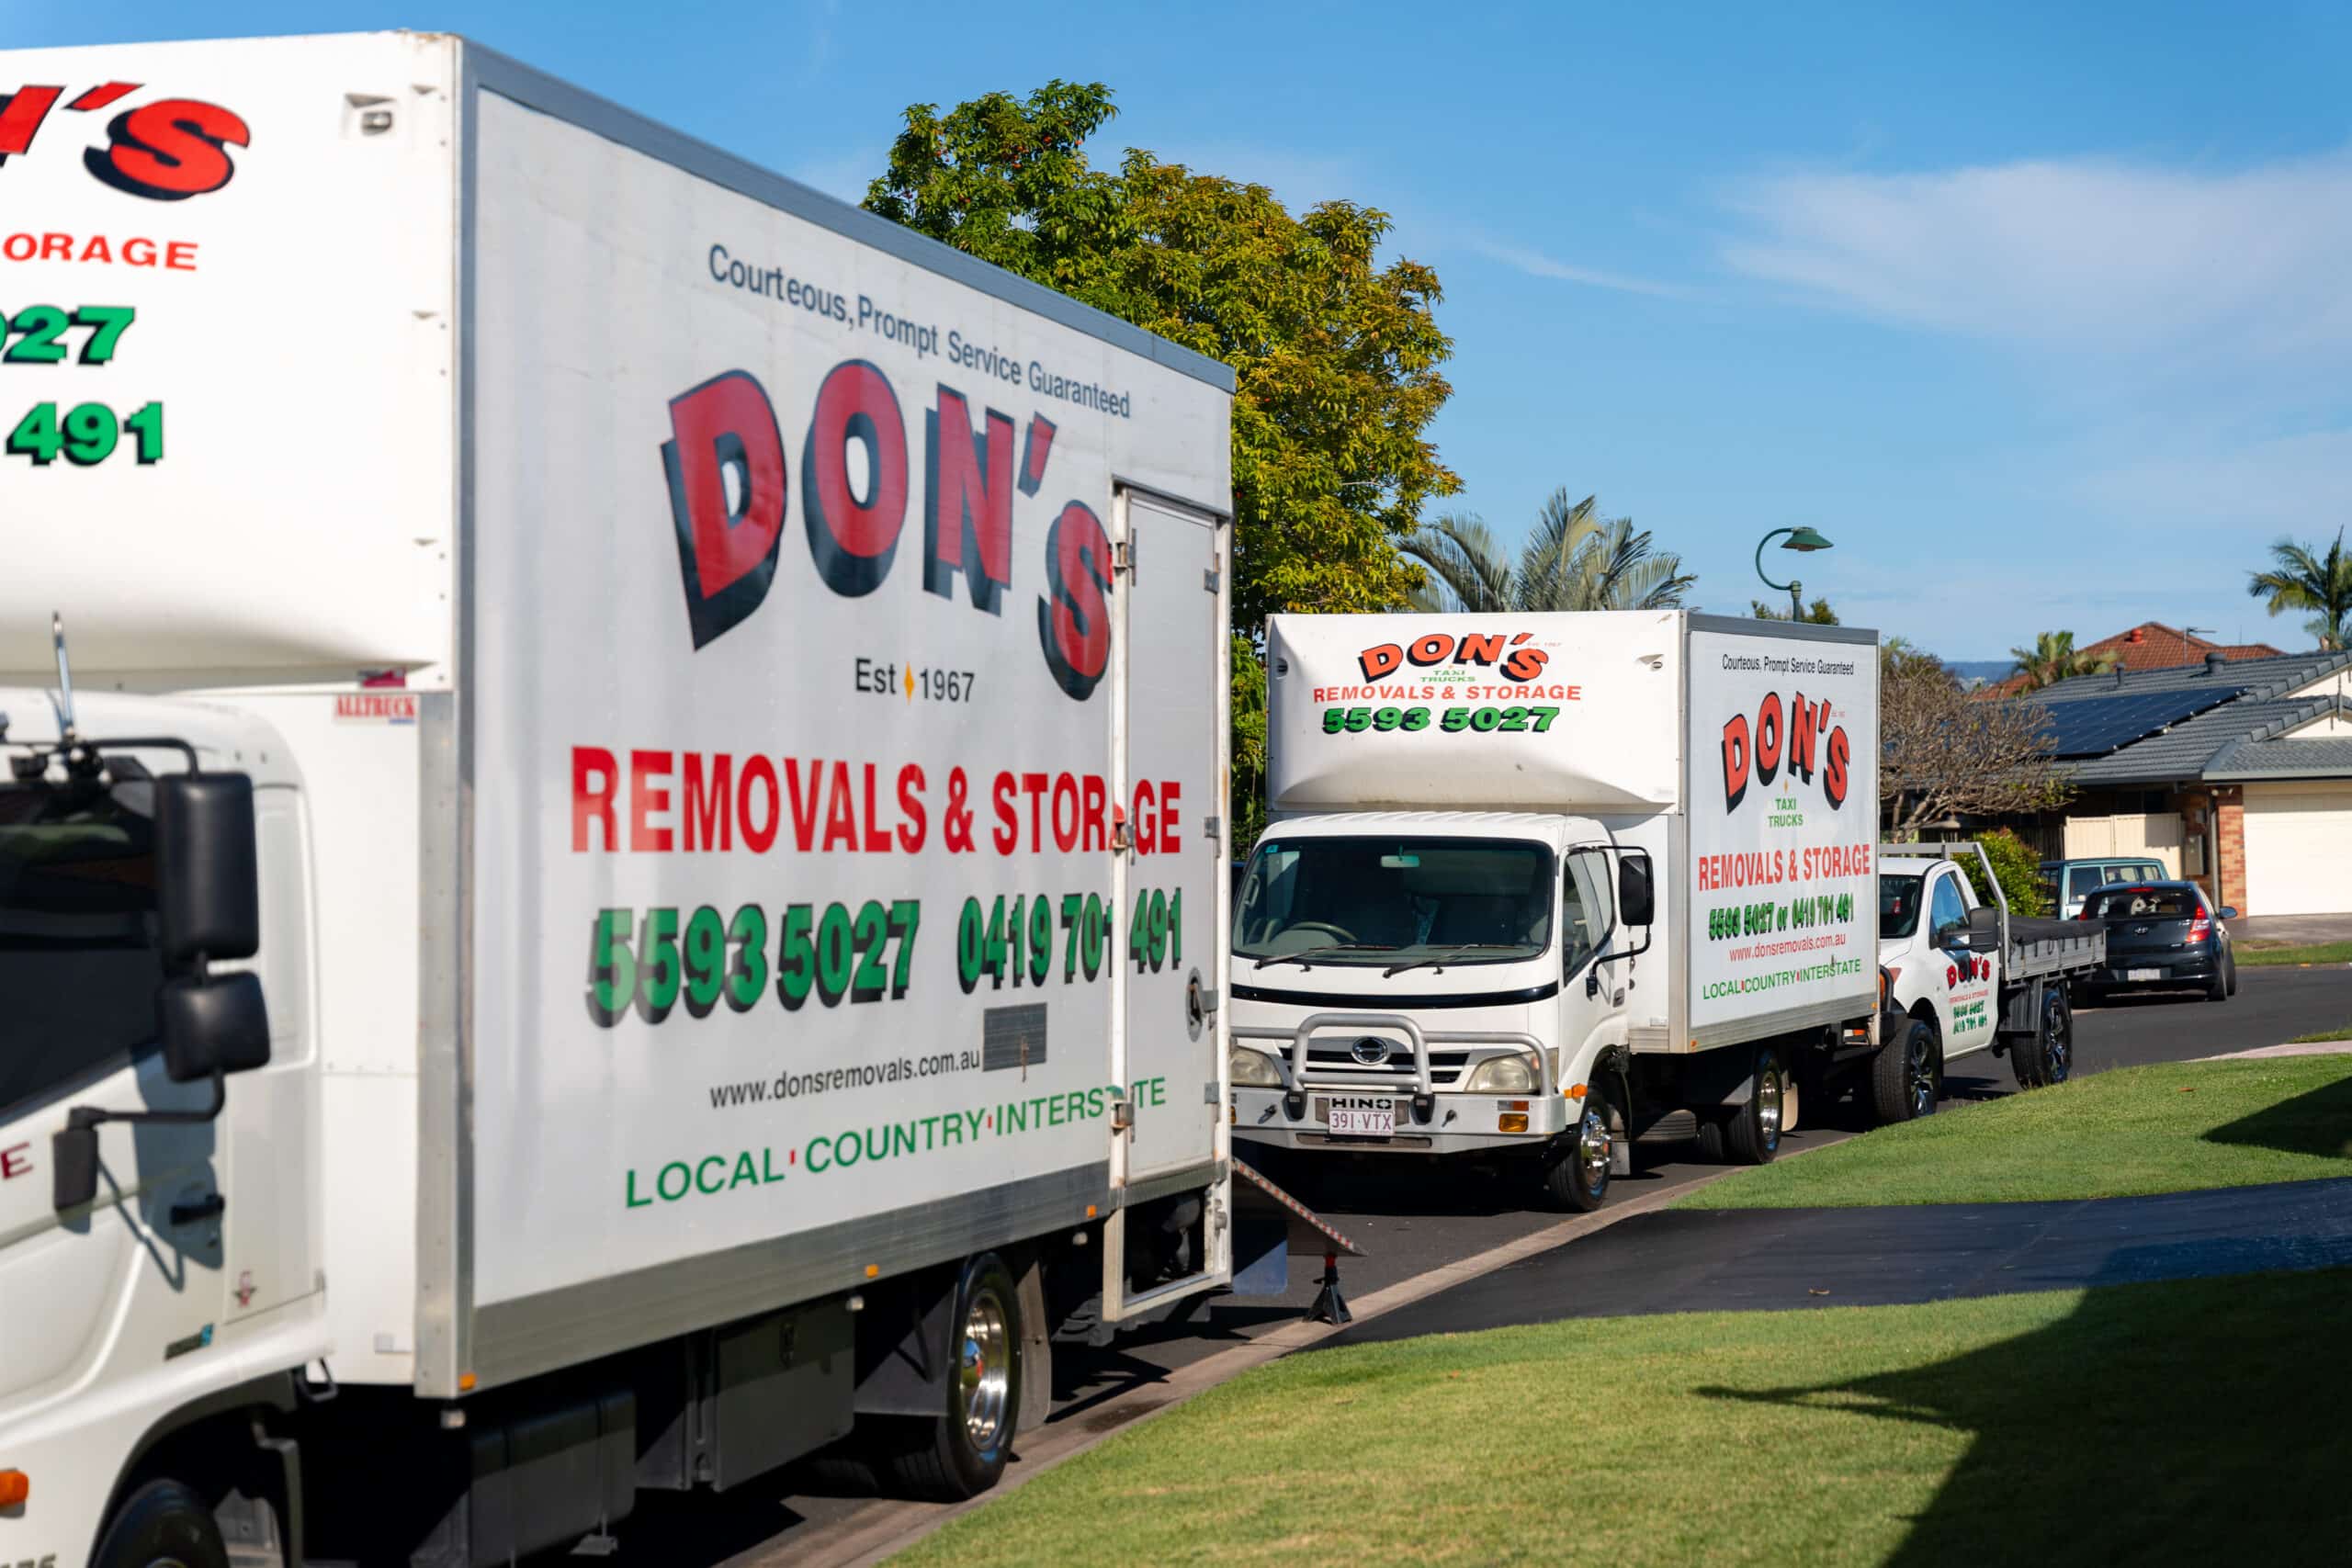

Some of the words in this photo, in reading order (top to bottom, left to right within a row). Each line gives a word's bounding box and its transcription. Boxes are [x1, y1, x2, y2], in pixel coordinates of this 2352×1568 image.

[3, 232, 198, 271] ORAGE
[0, 305, 136, 366] 27
[708, 243, 854, 331] Courteous,
[857, 294, 939, 360] Prompt
[947, 329, 1022, 386] Service
[1028, 360, 1131, 419] Guaranteed
[6, 401, 164, 467] 491
[661, 358, 1113, 702] DON'S
[854, 657, 897, 695] Est
[919, 668, 976, 704] 1967
[1358, 632, 1549, 683] DON'S
[1722, 653, 1762, 672] Courteous,
[1763, 656, 1790, 676] Prompt
[1791, 658, 1815, 674] Service
[1817, 660, 1854, 676] Guaranteed
[1313, 685, 1435, 704] REMOVALS
[1441, 685, 1456, 700] &
[1465, 684, 1581, 701] STORAGE
[1322, 706, 1431, 734] 5593
[1440, 705, 1560, 734] 5027
[1721, 690, 1850, 816] DON'S
[571, 744, 927, 854] REMOVALS
[943, 765, 977, 854] &
[1768, 815, 1804, 828] TRUCKS
[1775, 798, 1797, 810] TAXI
[1698, 850, 1783, 891] REMOVALS
[1788, 850, 1799, 882] &
[1803, 843, 1871, 882] STORAGE
[1708, 906, 1741, 941] 5593
[1744, 901, 1775, 937] 5027
[1776, 906, 1788, 932] or
[584, 903, 770, 1030] 5593
[775, 898, 922, 1012] 5027
[957, 891, 1053, 996] 0419
[1129, 886, 1182, 975] 491
[1729, 933, 1846, 962] www.donsremovals.com.au
[1702, 980, 1742, 1000] LOCAL
[709, 1048, 981, 1109] www.donsremovals.com.au
[1332, 1098, 1392, 1110] HINO
[625, 1145, 786, 1209] LOCAL
[803, 1106, 986, 1175] COUNTRY
